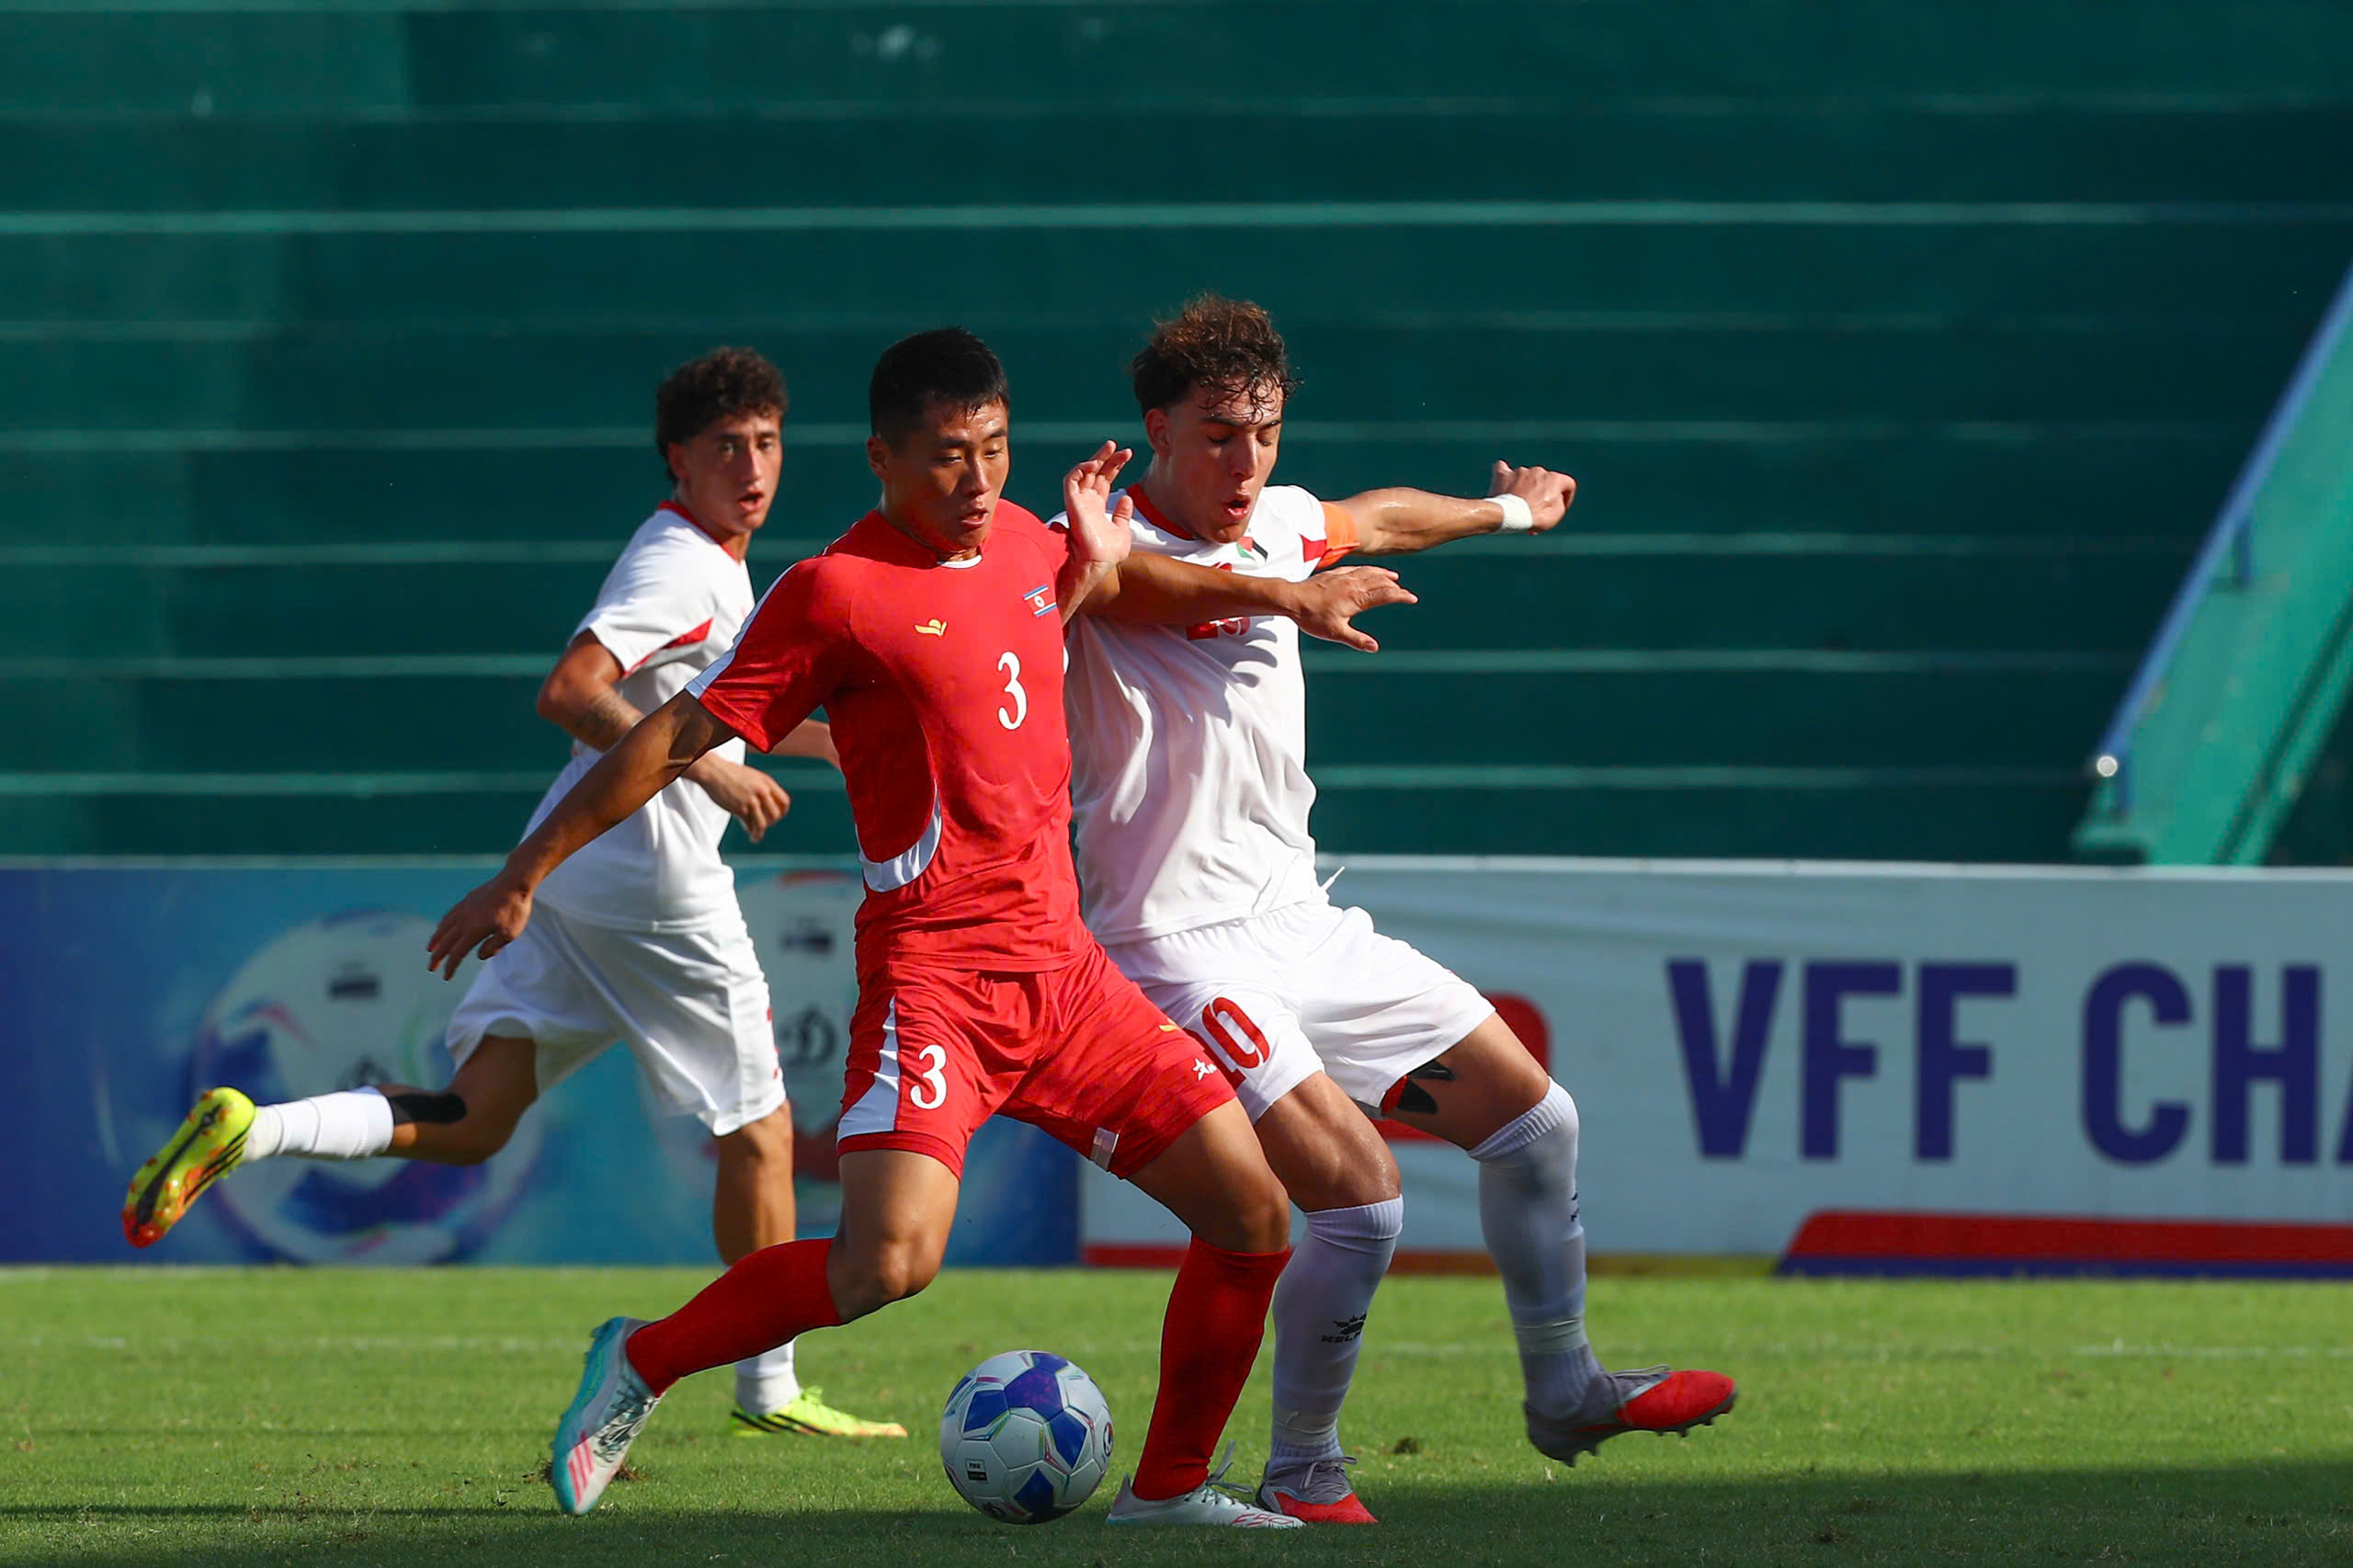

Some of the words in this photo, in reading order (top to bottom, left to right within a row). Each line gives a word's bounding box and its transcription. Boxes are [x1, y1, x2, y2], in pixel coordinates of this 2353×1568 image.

[996, 650, 1028, 731] 3
[910, 1044, 948, 1109] 3
[1665, 958, 2018, 1162] VFF
[2081, 960, 2353, 1168] CH
